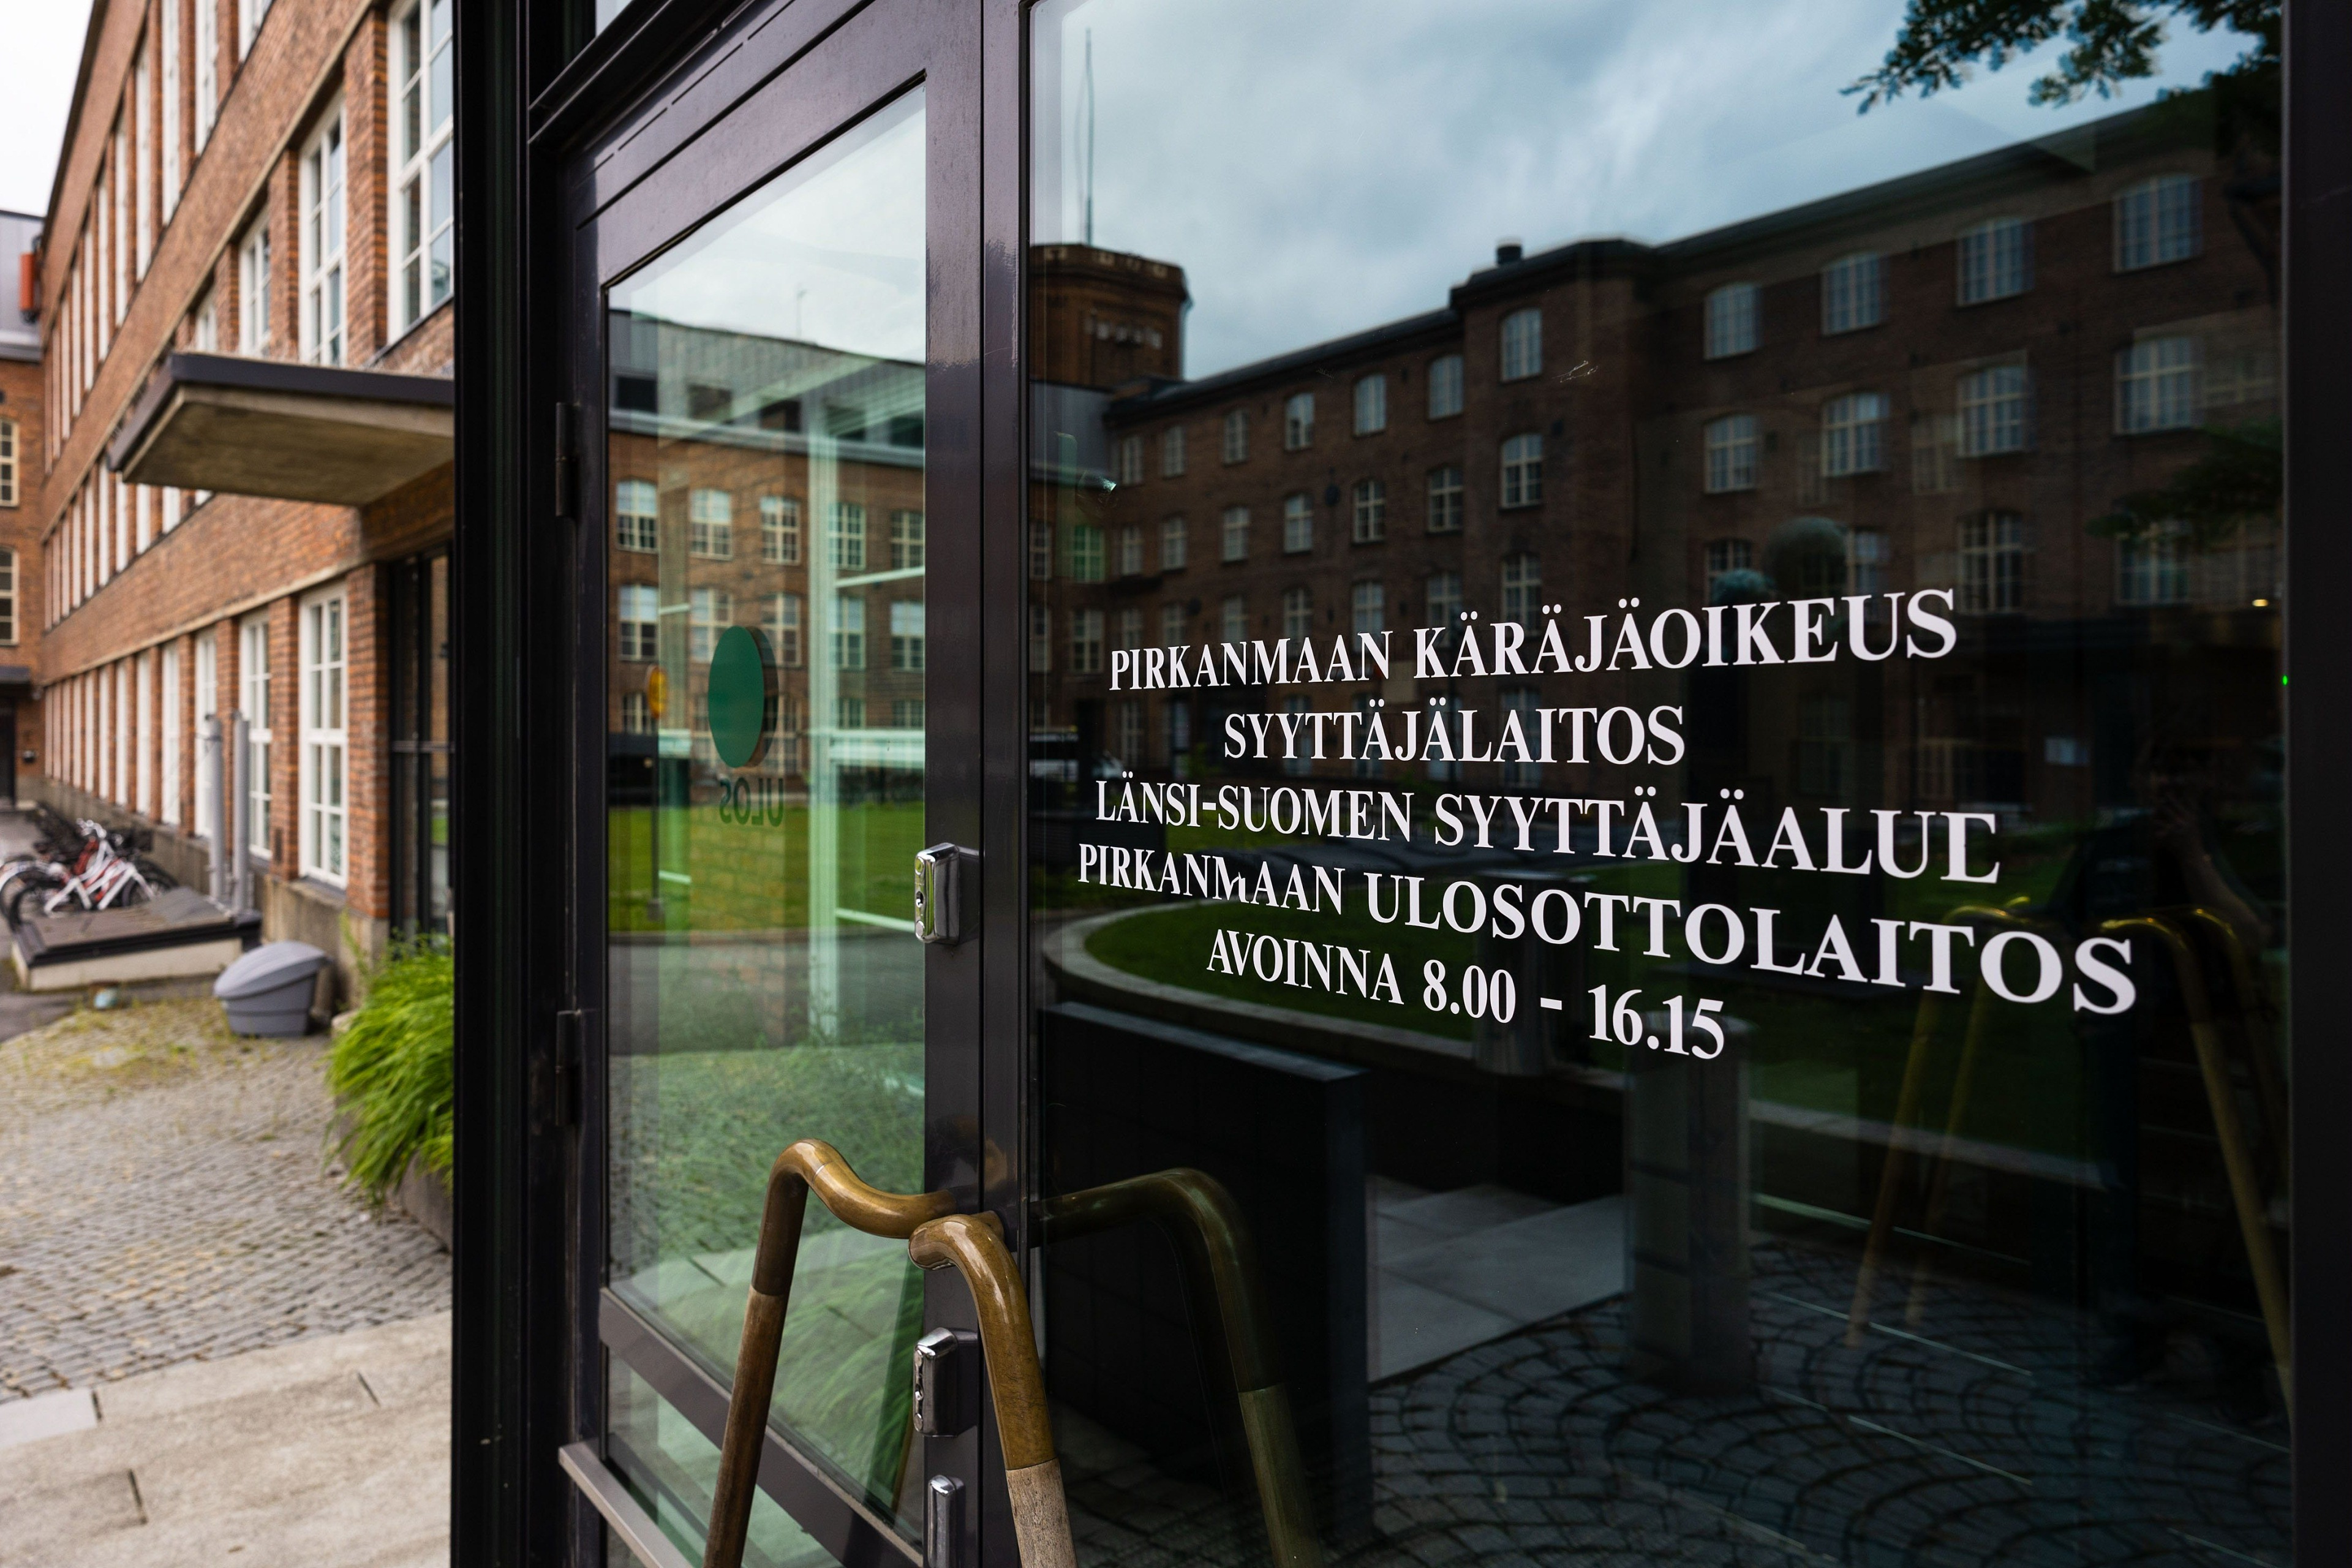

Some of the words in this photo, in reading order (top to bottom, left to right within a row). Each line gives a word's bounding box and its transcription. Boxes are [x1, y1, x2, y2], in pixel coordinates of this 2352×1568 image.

[1109, 630, 1393, 690] PIRKANMAAN
[1413, 589, 1956, 679] KÄRÄJÄOIKEUS
[1224, 697, 1684, 766] SYYTTÄJÄLAITOS
[1096, 771, 1415, 842] LÄNSI-SUOMEN
[1435, 786, 1999, 883] SYYTTÄJÄALUE
[1077, 843, 1346, 915] PIRKANMAAN
[1363, 872, 2135, 1014] ULOSOTTOLAITOS
[1206, 929, 1404, 1005] AVOINNA
[1423, 959, 1516, 1023] 8.00
[1588, 984, 1724, 1060] 16.15
